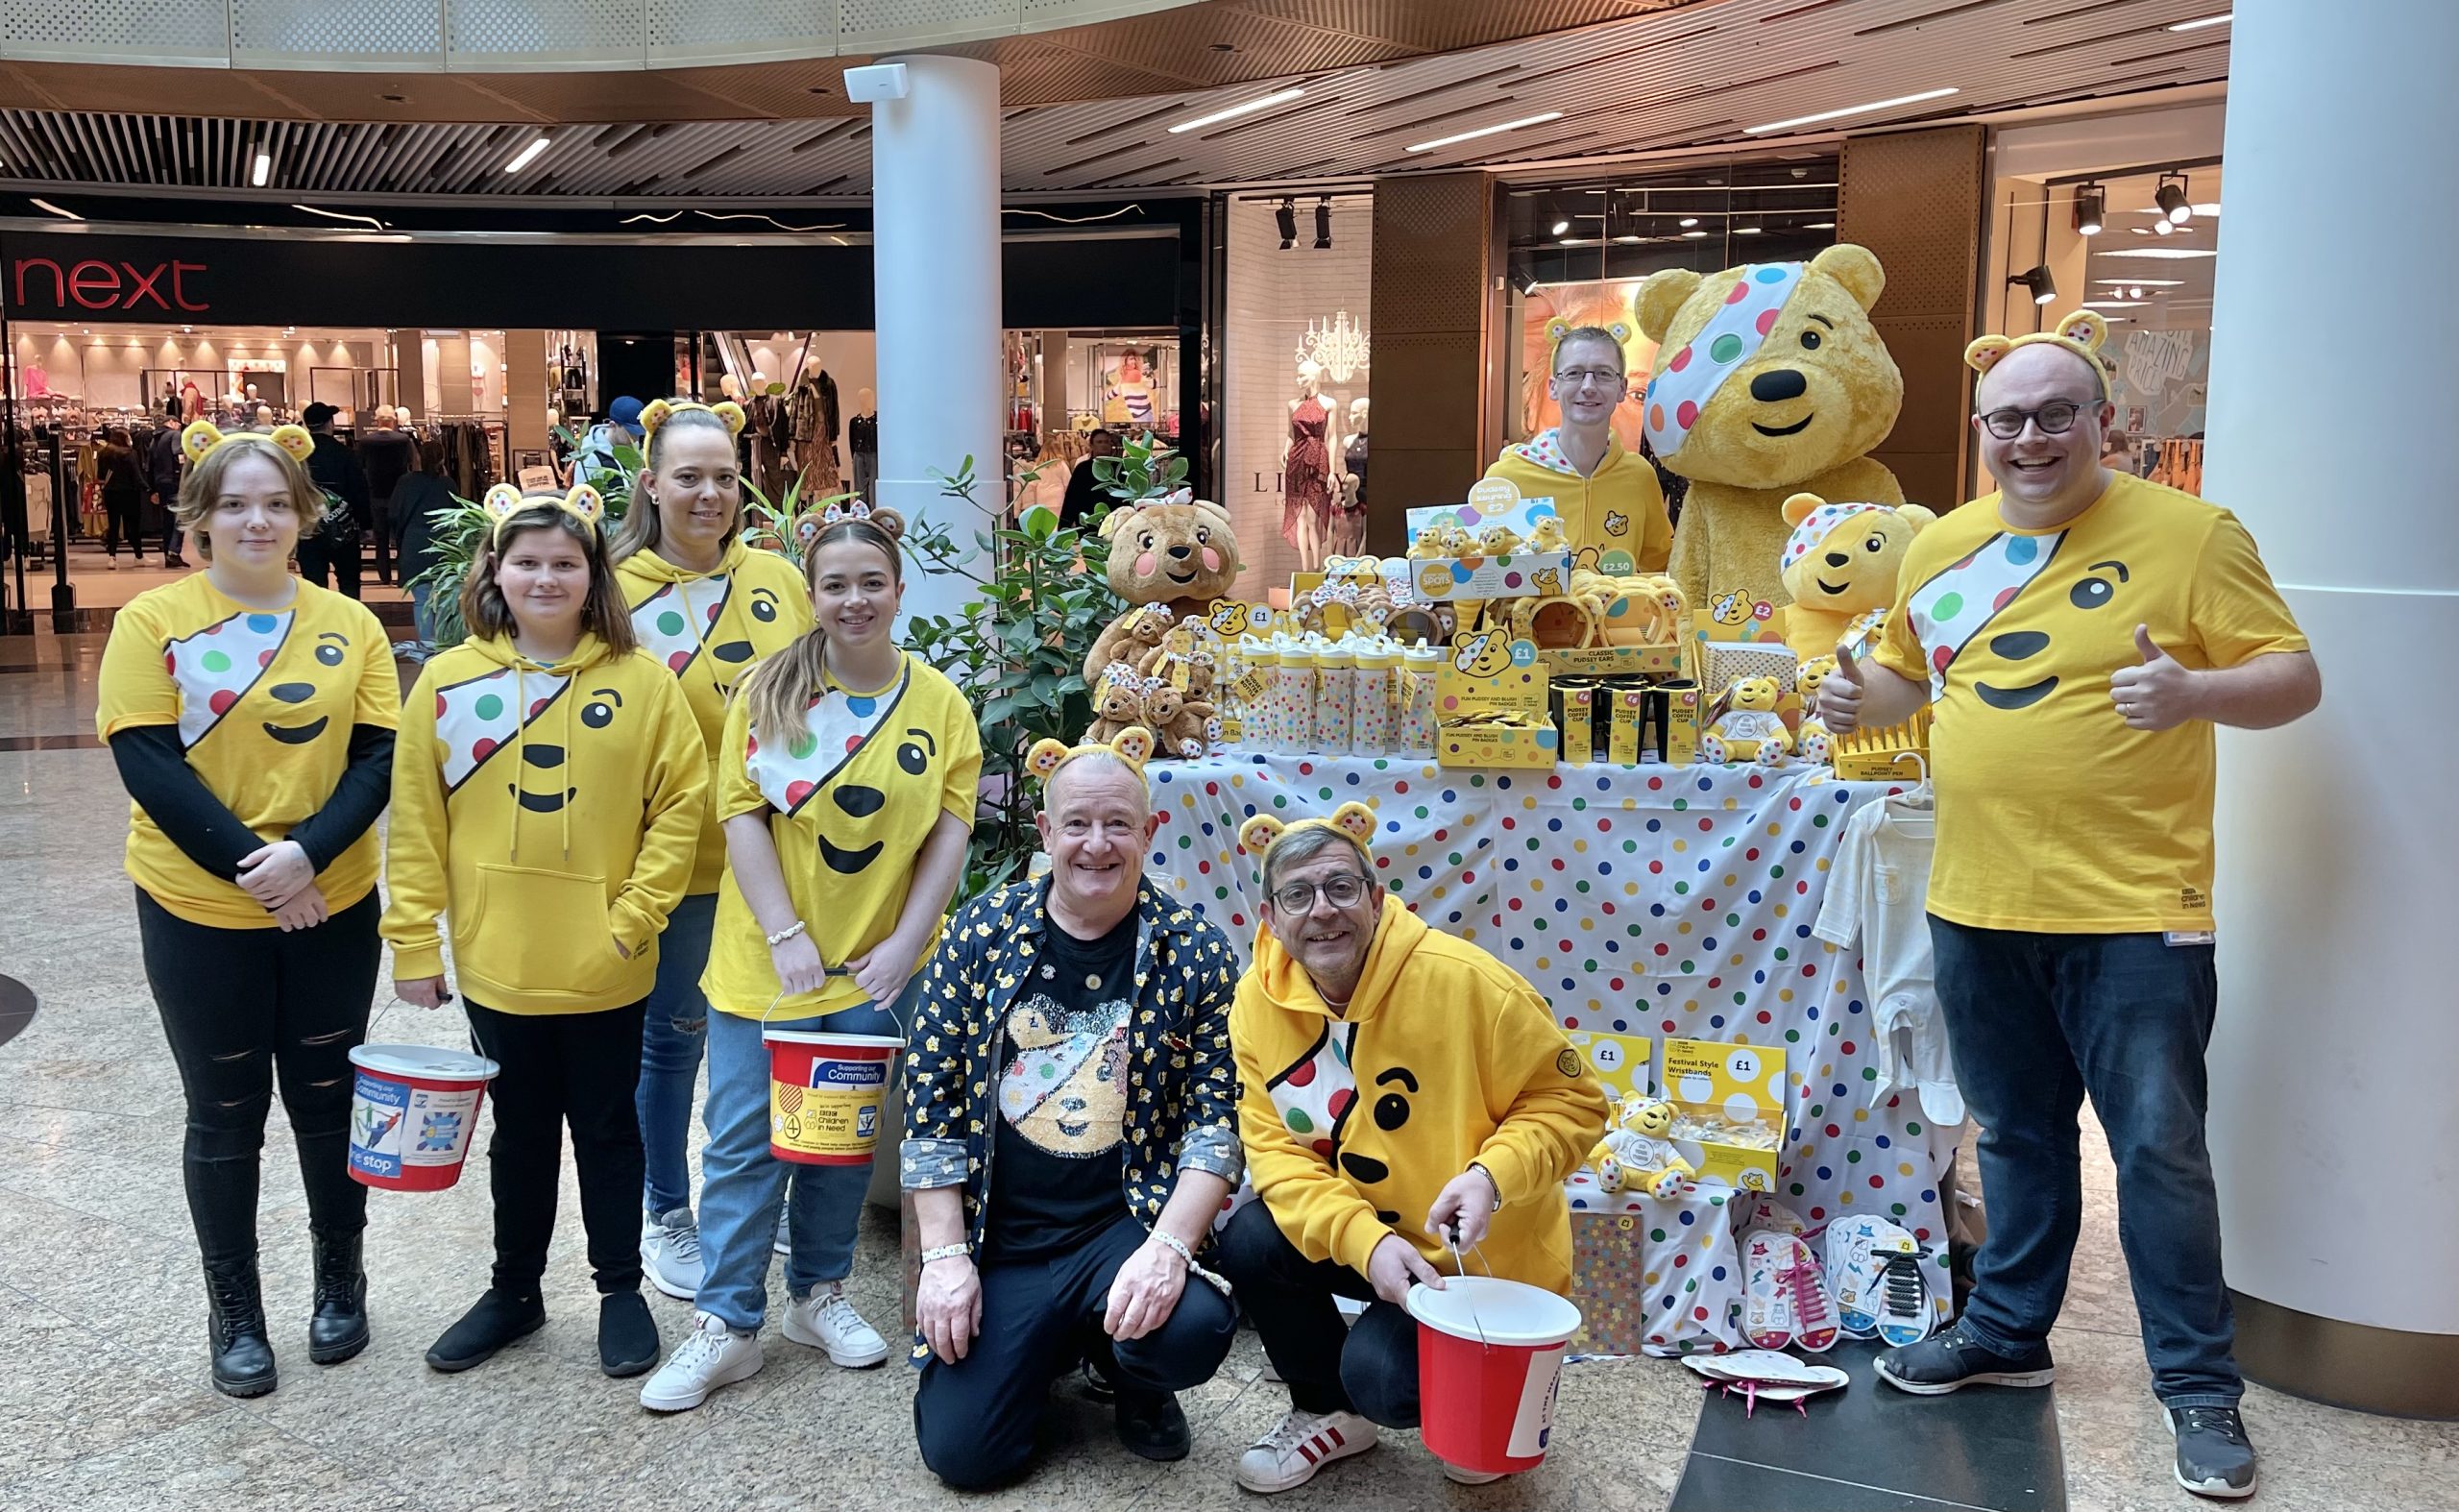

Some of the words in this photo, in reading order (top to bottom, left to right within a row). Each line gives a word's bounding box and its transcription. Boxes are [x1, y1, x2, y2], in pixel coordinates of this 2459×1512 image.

[15, 258, 210, 311] next
[2129, 332, 2190, 378] AMAZING
[1602, 562, 1630, 573] £2.50
[1254, 611, 1267, 622] £1
[1755, 605, 1771, 617] £2
[1514, 647, 1531, 660] £1
[1600, 1050, 1615, 1061] £1
[1668, 1058, 1697, 1066] Festival
[1699, 1060, 1719, 1068] Style
[1736, 1061, 1751, 1071] £1
[828, 1069, 881, 1083] Community
[1668, 1066, 1712, 1076] Wristbands
[355, 1080, 402, 1106] Community
[363, 1156, 392, 1174] stop
